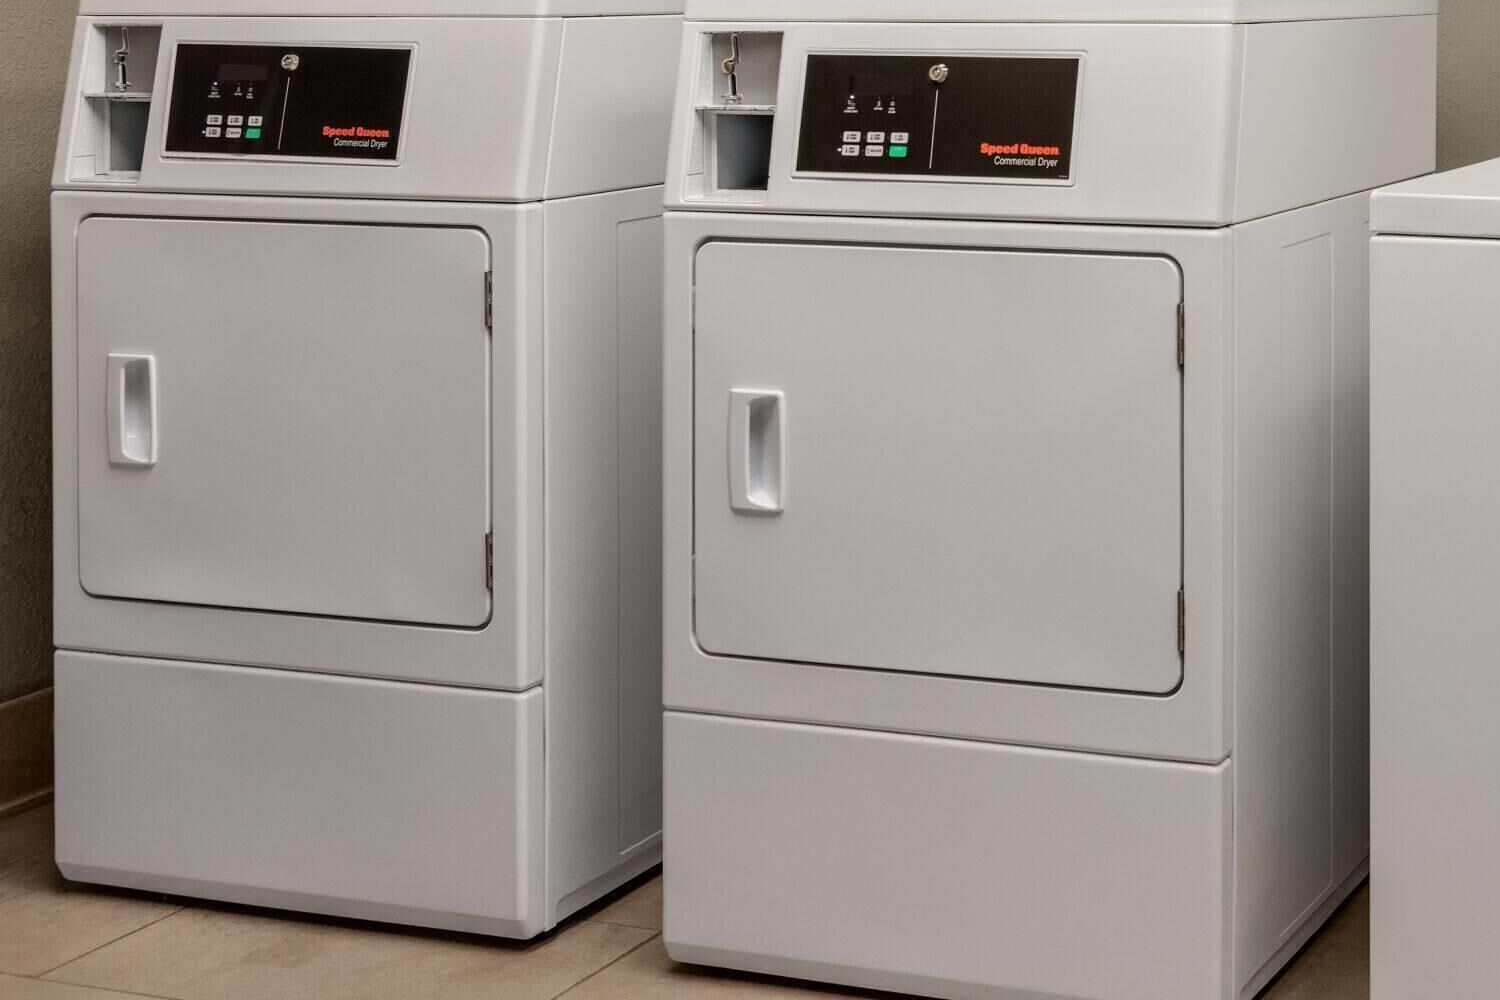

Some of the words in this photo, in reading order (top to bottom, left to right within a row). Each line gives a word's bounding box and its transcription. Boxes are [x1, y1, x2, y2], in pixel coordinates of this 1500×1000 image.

[322, 126, 355, 137] Speed
[356, 127, 389, 137] Queen
[333, 138, 369, 147] Commercial
[370, 140, 388, 149] Dryer
[980, 143, 1018, 156] Speed
[1020, 144, 1059, 155] Queen
[994, 156, 1036, 166] Commercial
[1037, 157, 1058, 168] Dryer
